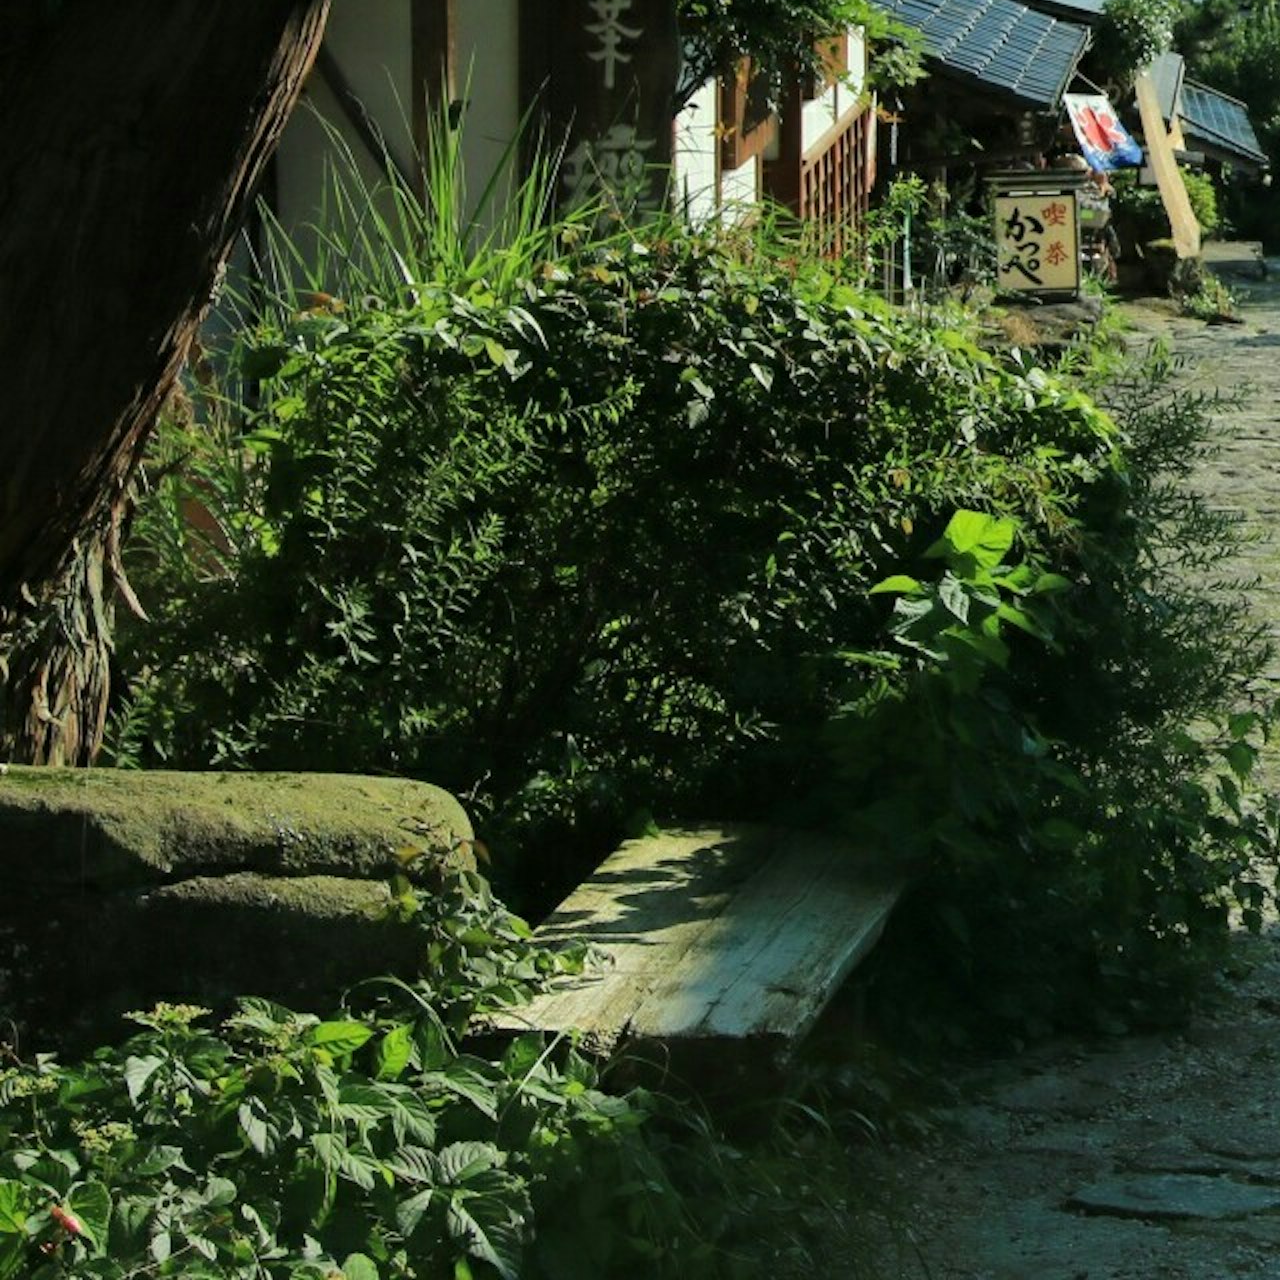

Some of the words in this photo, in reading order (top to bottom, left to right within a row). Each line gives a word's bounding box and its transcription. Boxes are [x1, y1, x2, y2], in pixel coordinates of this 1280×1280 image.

[1002, 207, 1044, 284] かっぺ
[1042, 202, 1068, 266] 喫茶
